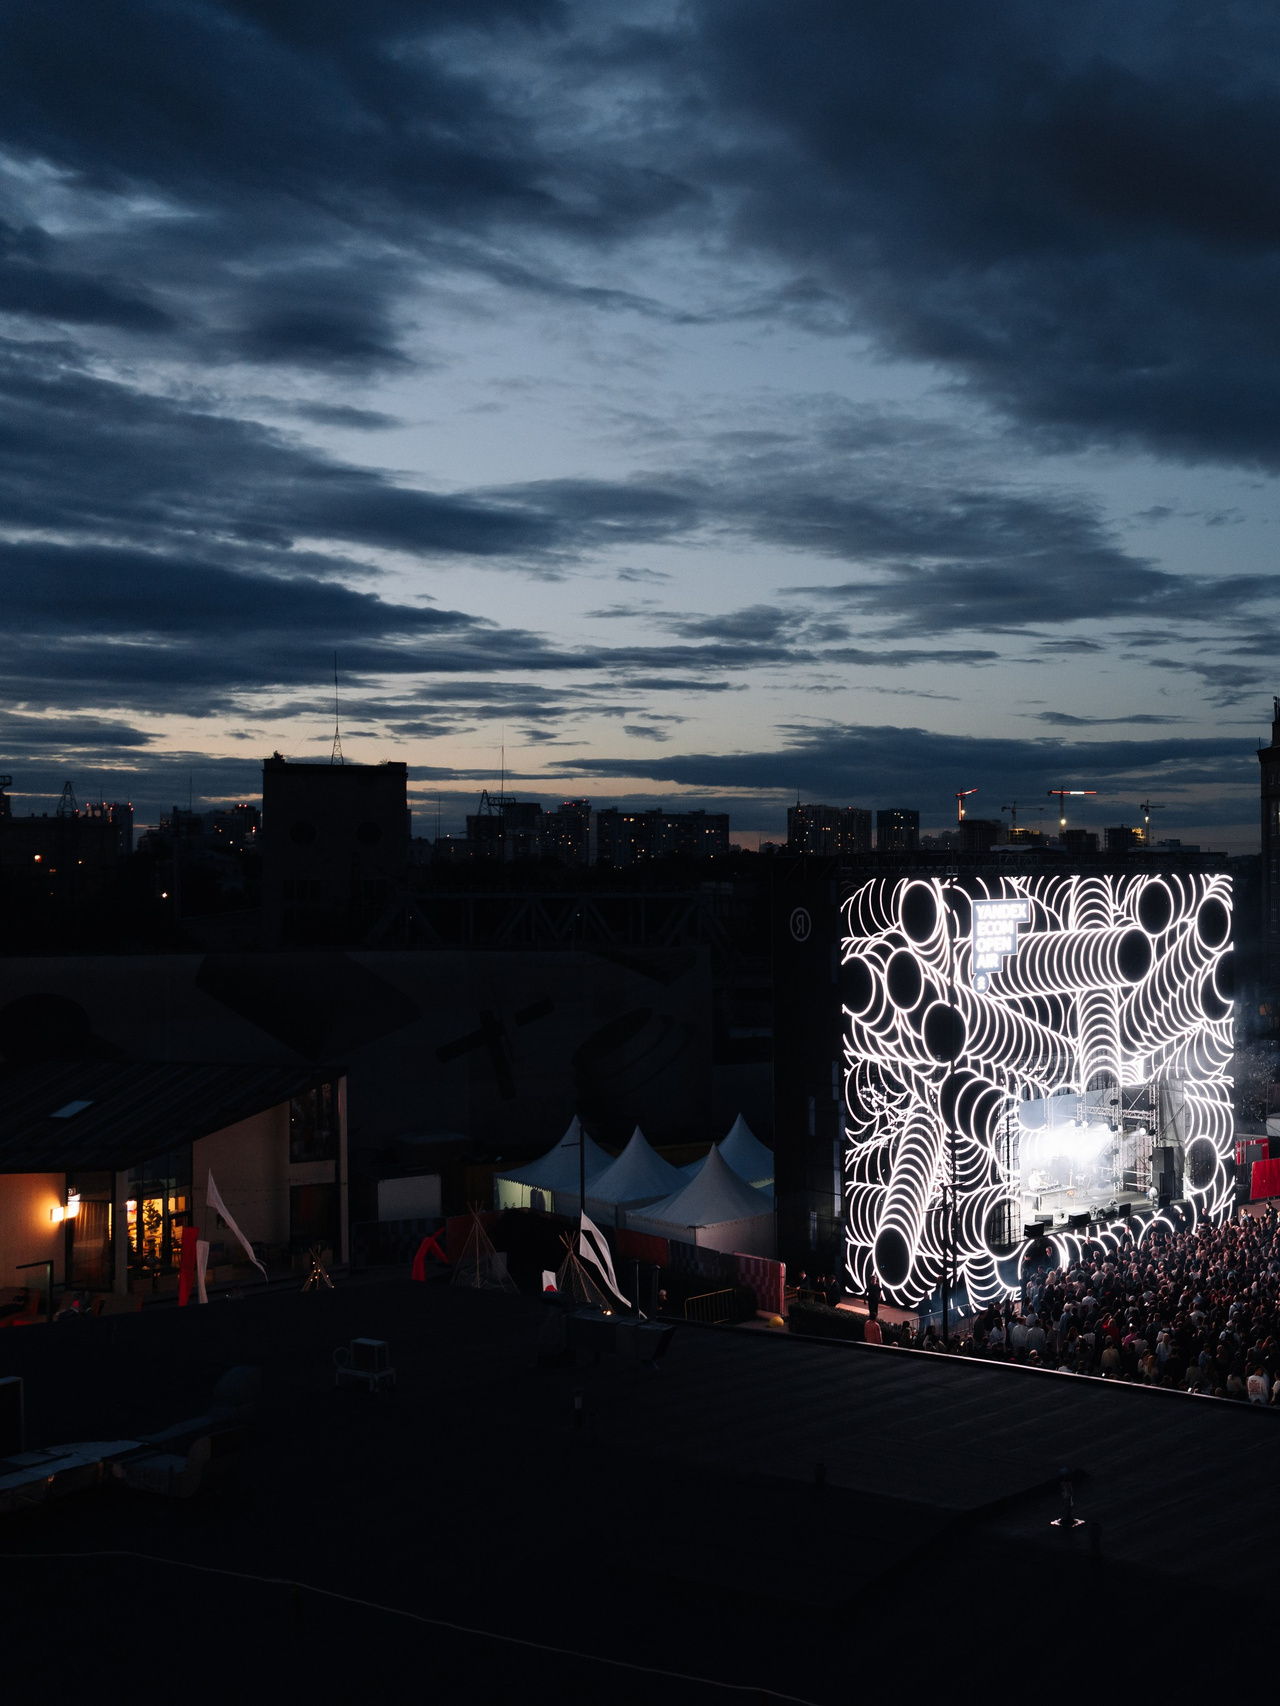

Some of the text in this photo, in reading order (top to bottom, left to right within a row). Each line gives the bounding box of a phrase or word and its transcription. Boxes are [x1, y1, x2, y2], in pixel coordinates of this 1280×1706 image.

[975, 903, 1027, 920] YANDEX
[976, 920, 1014, 937] ECOM
[975, 936, 1012, 953] OPEN
[976, 953, 999, 969] AIR
